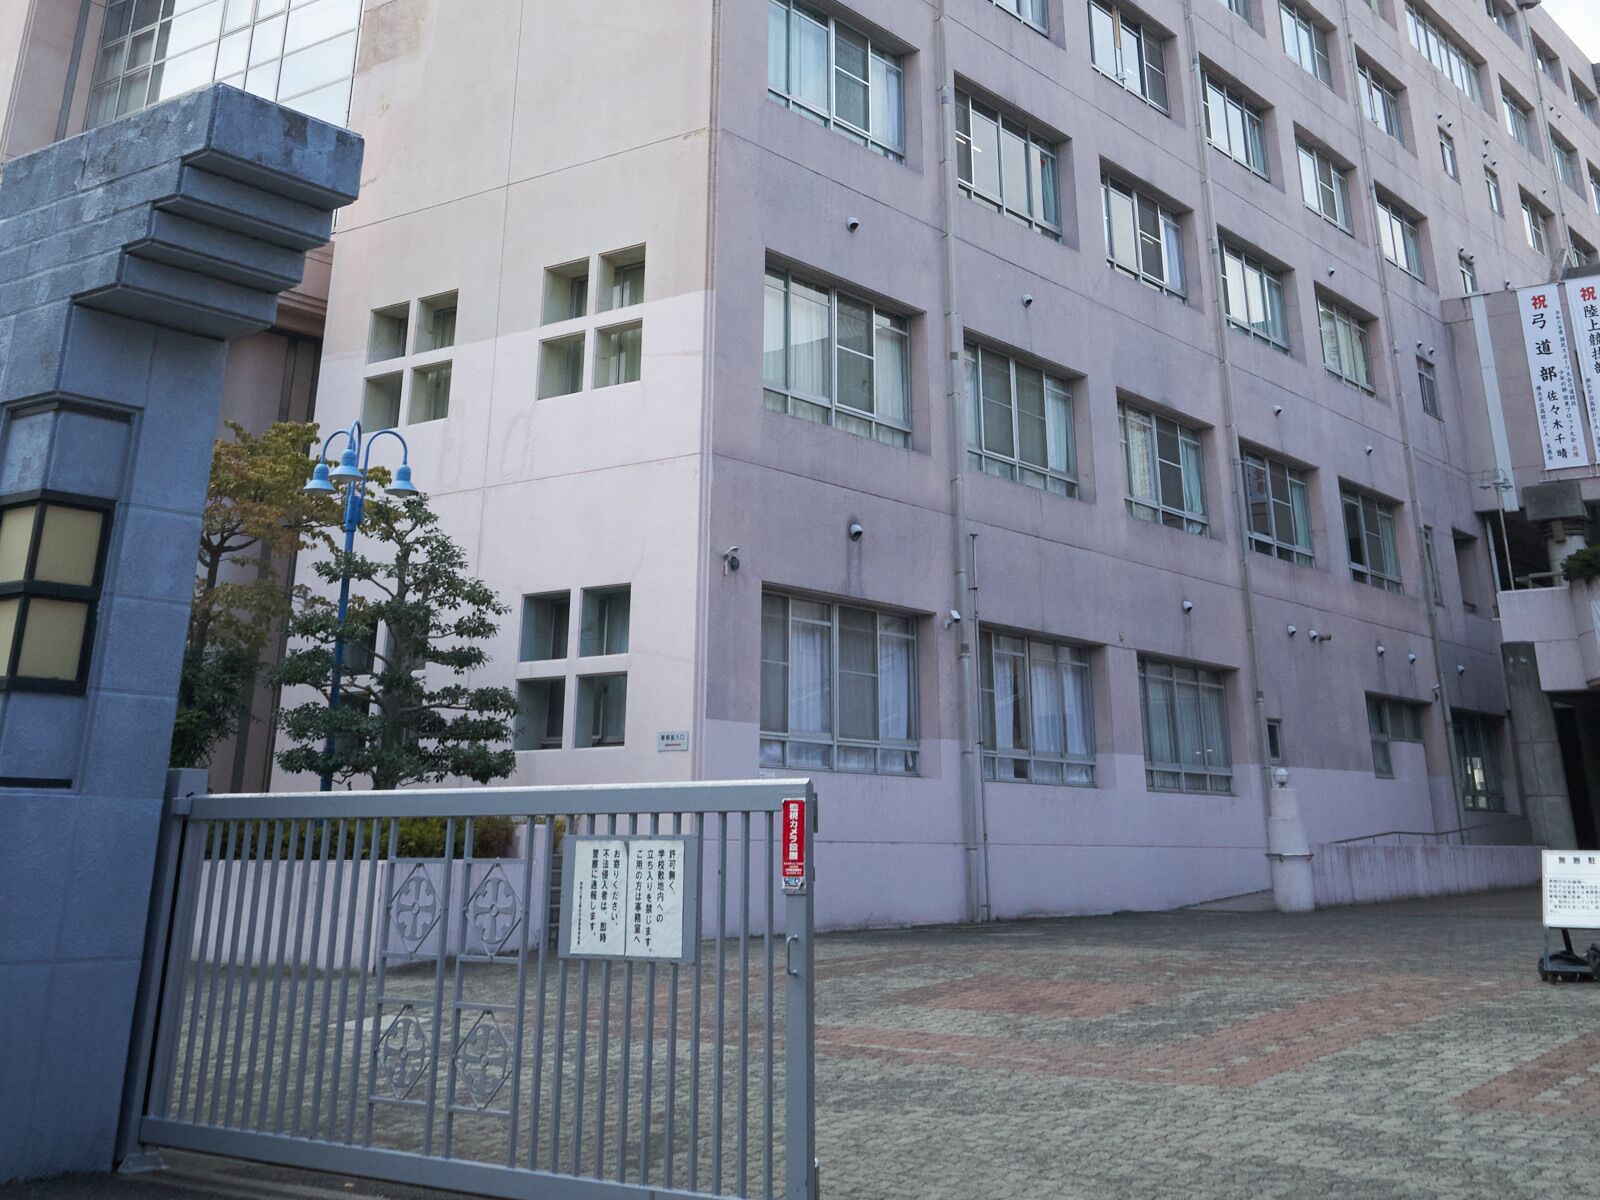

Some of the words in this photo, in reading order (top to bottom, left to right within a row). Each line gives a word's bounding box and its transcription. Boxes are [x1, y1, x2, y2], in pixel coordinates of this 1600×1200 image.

[1531, 294, 1548, 311] 祝
[1580, 286, 1597, 302] 祝
[1532, 313, 1558, 383] 弓道部
[1547, 389, 1569, 460] 佐々木千晴
[589, 849, 599, 937] 警察に通報します。
[633, 849, 644, 944] ご用の方は事務室へ
[645, 850, 655, 953] 立ち入りを禁じます。
[656, 850, 666, 923] 学校敷地内への
[668, 849, 677, 896] 許可無く、
